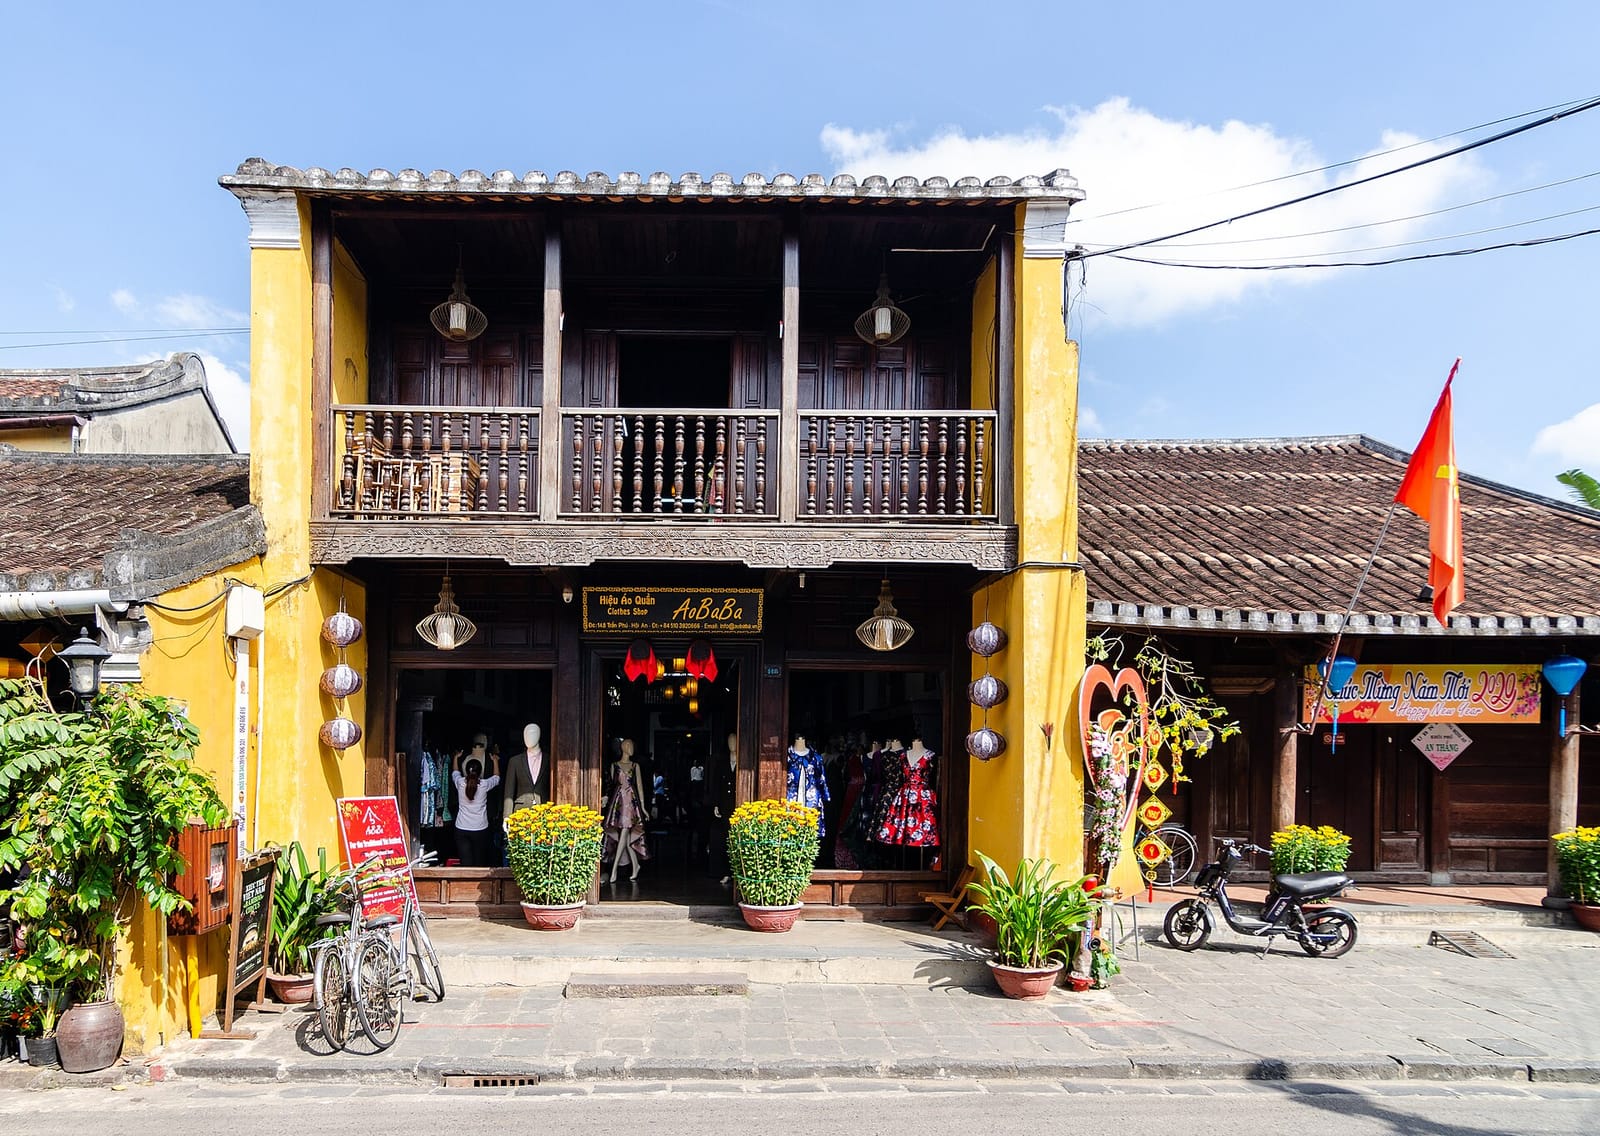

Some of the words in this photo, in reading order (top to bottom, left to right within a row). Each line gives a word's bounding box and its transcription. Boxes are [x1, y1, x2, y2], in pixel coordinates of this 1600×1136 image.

[599, 595, 618, 607] Hiệu
[621, 593, 633, 605] Áo
[635, 593, 656, 606] Quần
[607, 607, 631, 616] Clothes
[633, 607, 649, 616] Shop
[672, 597, 743, 621] AoBaBa
[1361, 672, 1401, 709] Mừng
[1404, 672, 1438, 699] Năm
[1438, 671, 1470, 700] Mới
[1472, 670, 1517, 712] 2020
[1397, 702, 1428, 720] Happy
[1431, 702, 1455, 717] New
[1458, 702, 1482, 717] Year
[1425, 743, 1435, 752] AN
